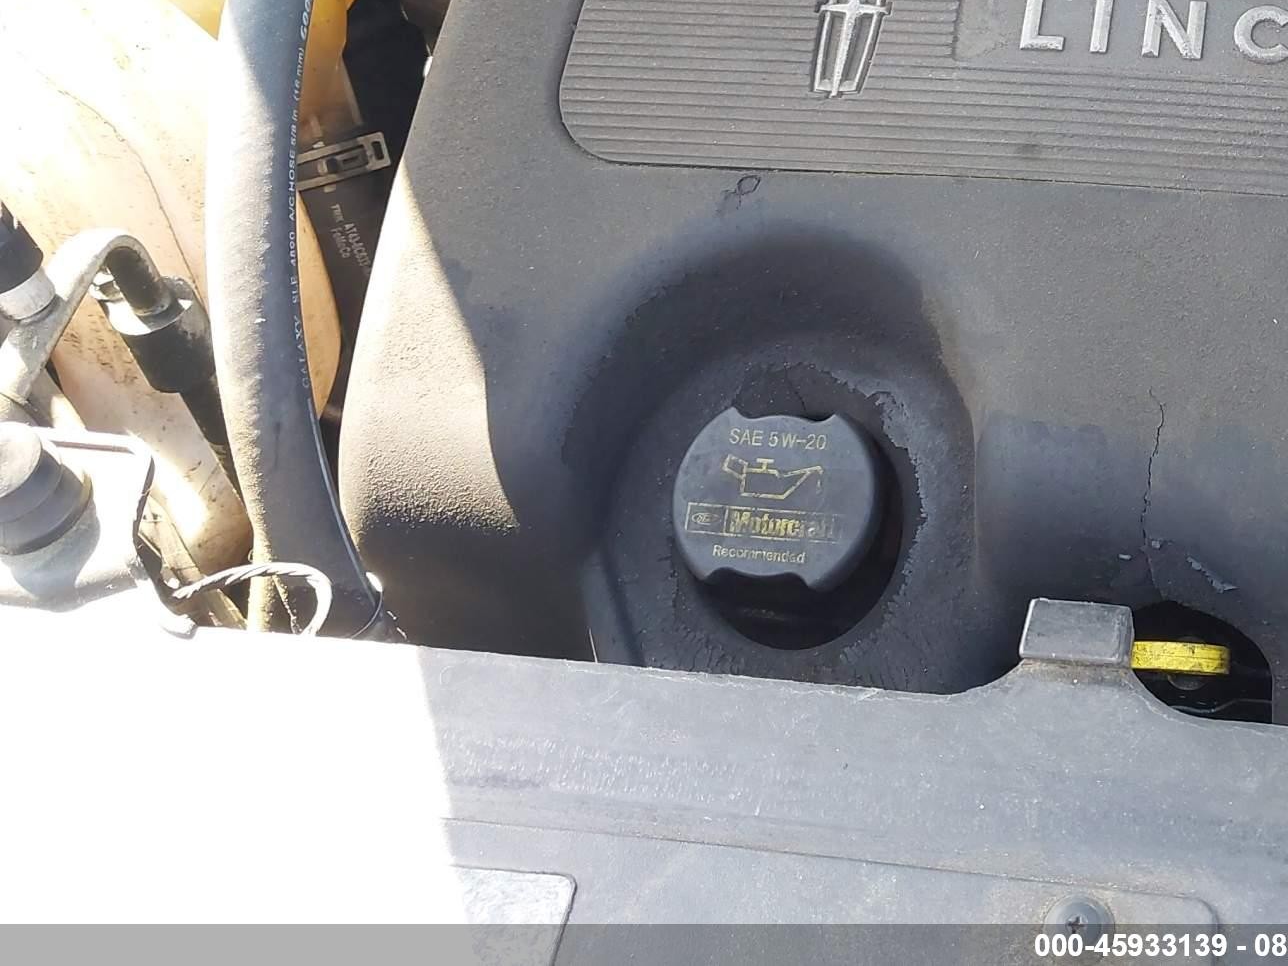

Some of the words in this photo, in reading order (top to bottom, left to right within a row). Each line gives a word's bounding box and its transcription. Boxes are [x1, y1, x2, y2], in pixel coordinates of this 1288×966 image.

[288, 150, 297, 192] HOSE
[728, 428, 764, 447] SAE
[712, 544, 807, 564] Recommended
